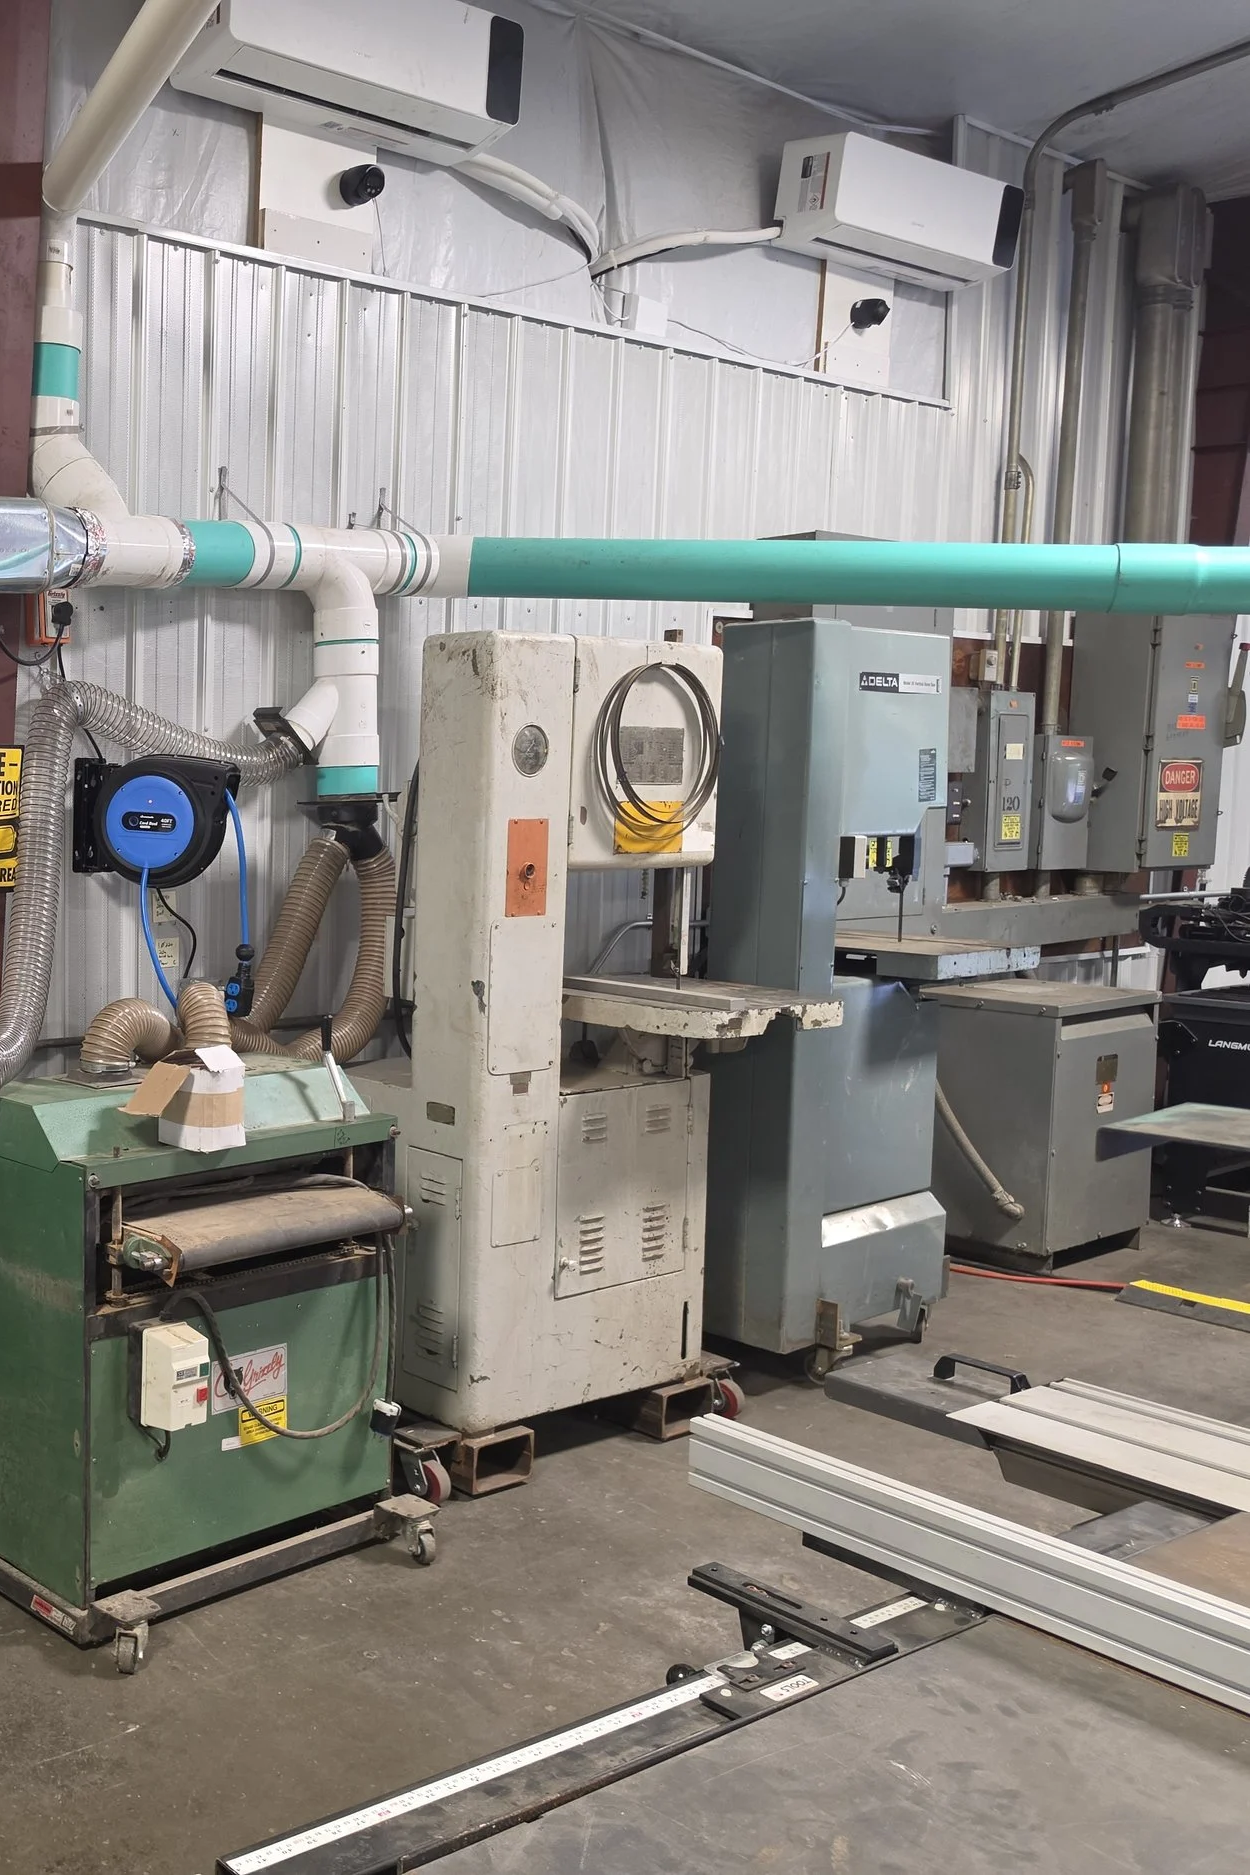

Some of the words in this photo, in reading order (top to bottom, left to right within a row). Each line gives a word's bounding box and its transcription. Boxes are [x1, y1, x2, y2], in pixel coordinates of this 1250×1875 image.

[869, 676, 898, 687] DELTA
[1165, 770, 1196, 784] DANGER
[1002, 796, 1020, 811] 120
[243, 1352, 285, 1396] Grizzly
[780, 1679, 812, 1692] TOOLS
